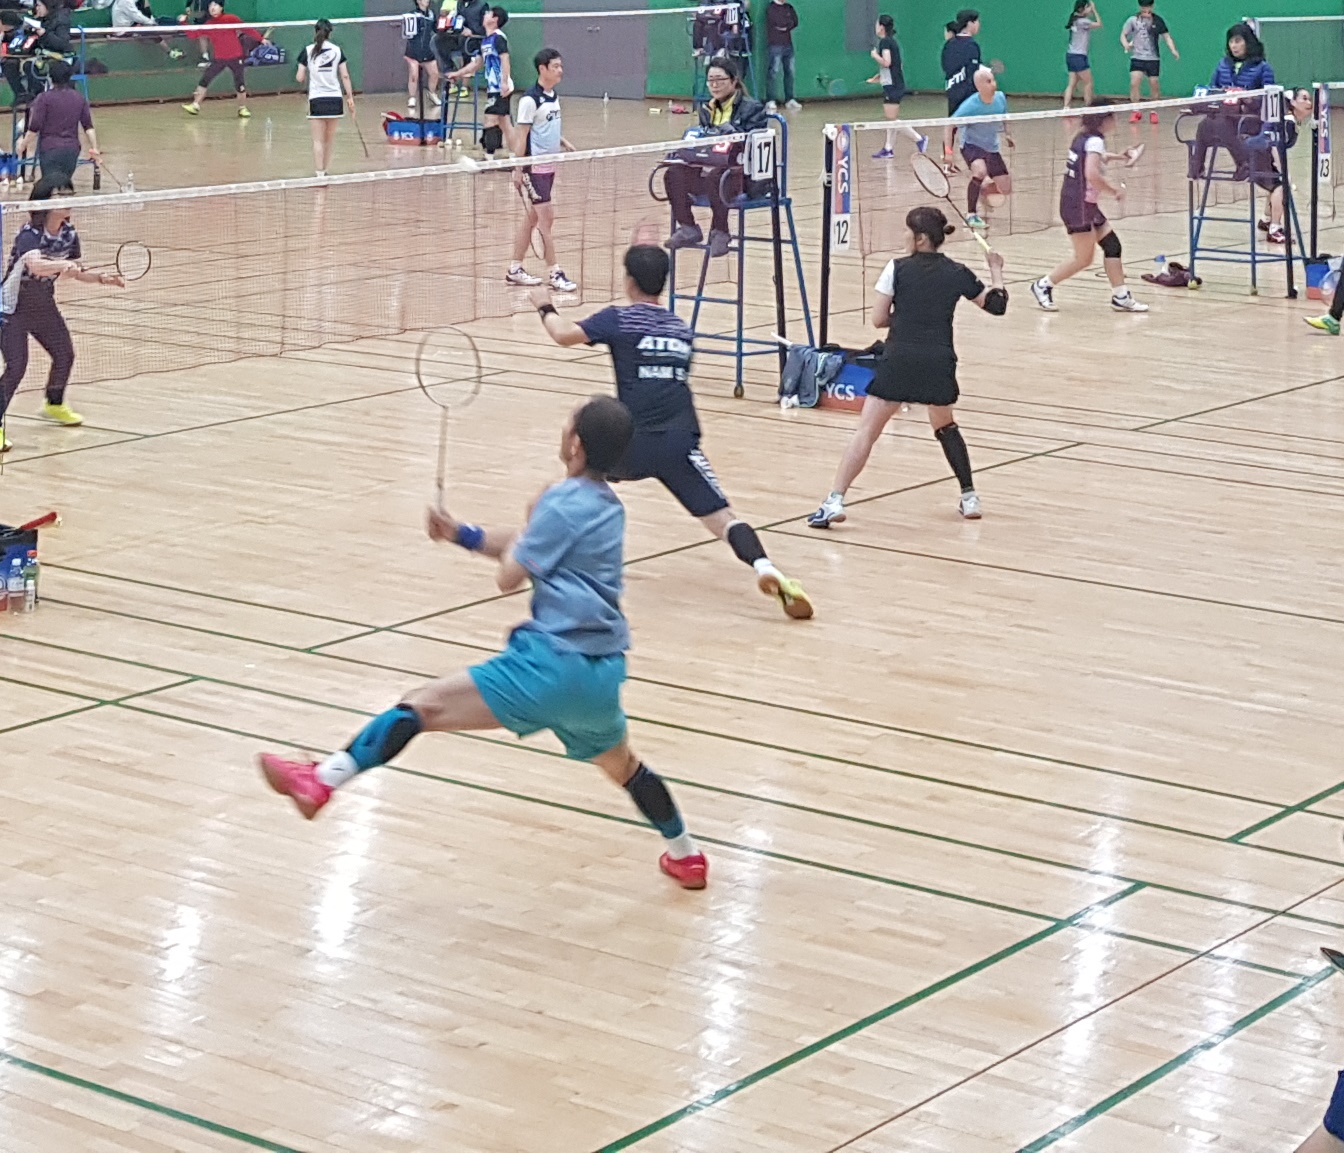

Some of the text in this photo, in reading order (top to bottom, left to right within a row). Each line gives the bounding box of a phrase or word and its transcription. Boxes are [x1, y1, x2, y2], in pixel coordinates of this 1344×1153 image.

[407, 17, 416, 33] 17
[1269, 93, 1278, 118] 17
[1320, 107, 1329, 138] YCS
[757, 141, 772, 174] 17
[1320, 157, 1330, 178] 13
[837, 155, 849, 194] YCS
[836, 219, 850, 245] 12
[825, 382, 856, 402] YCS
